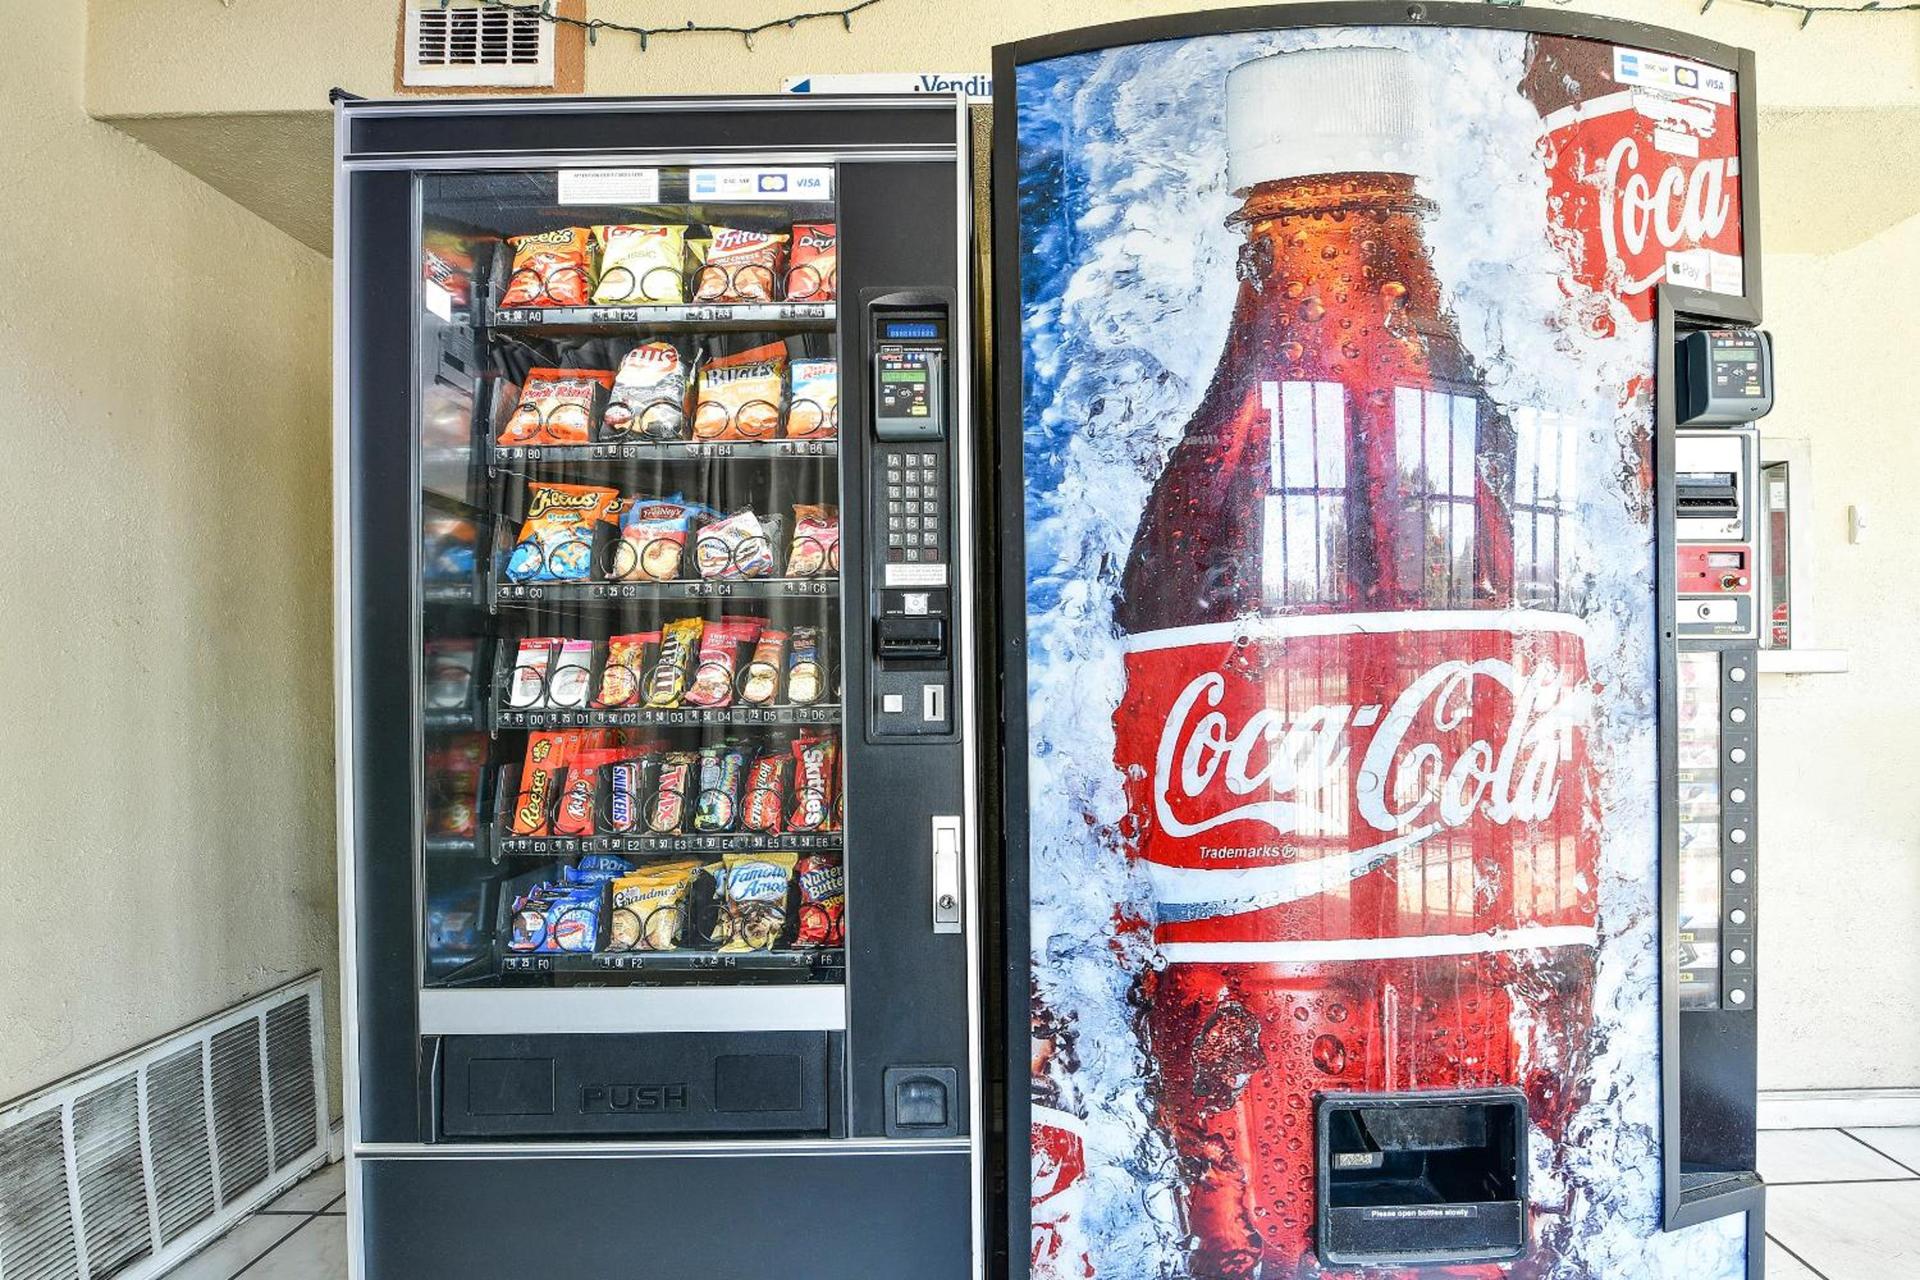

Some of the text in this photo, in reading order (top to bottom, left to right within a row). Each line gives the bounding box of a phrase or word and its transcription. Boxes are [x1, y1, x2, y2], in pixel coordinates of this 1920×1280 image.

[796, 178, 821, 188] VISA
[1154, 658, 1563, 839] Coca-Cola
[580, 1083, 687, 1113] PUSH
[1371, 1209, 1396, 1217] Please
[1397, 1210, 1416, 1219] open
[1418, 1208, 1444, 1217] bottles
